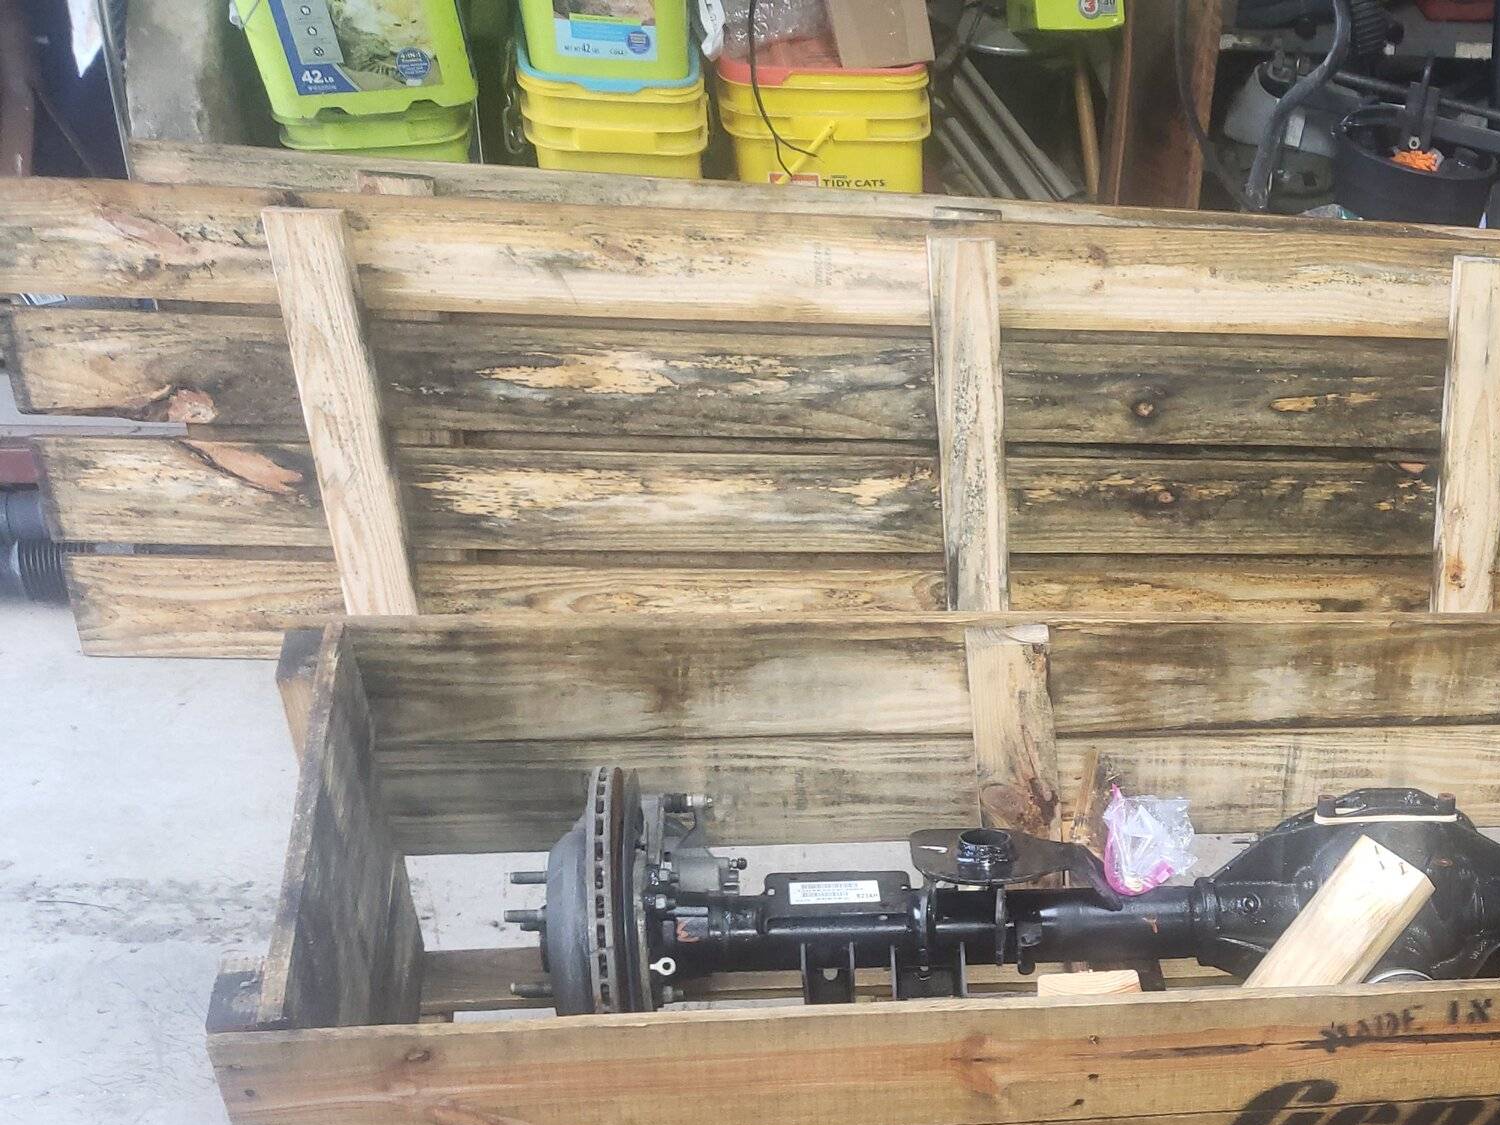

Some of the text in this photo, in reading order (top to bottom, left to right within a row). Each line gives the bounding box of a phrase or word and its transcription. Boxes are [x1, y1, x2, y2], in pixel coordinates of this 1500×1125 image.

[301, 69, 324, 84] 42
[822, 179, 886, 188] TIDY CATS
